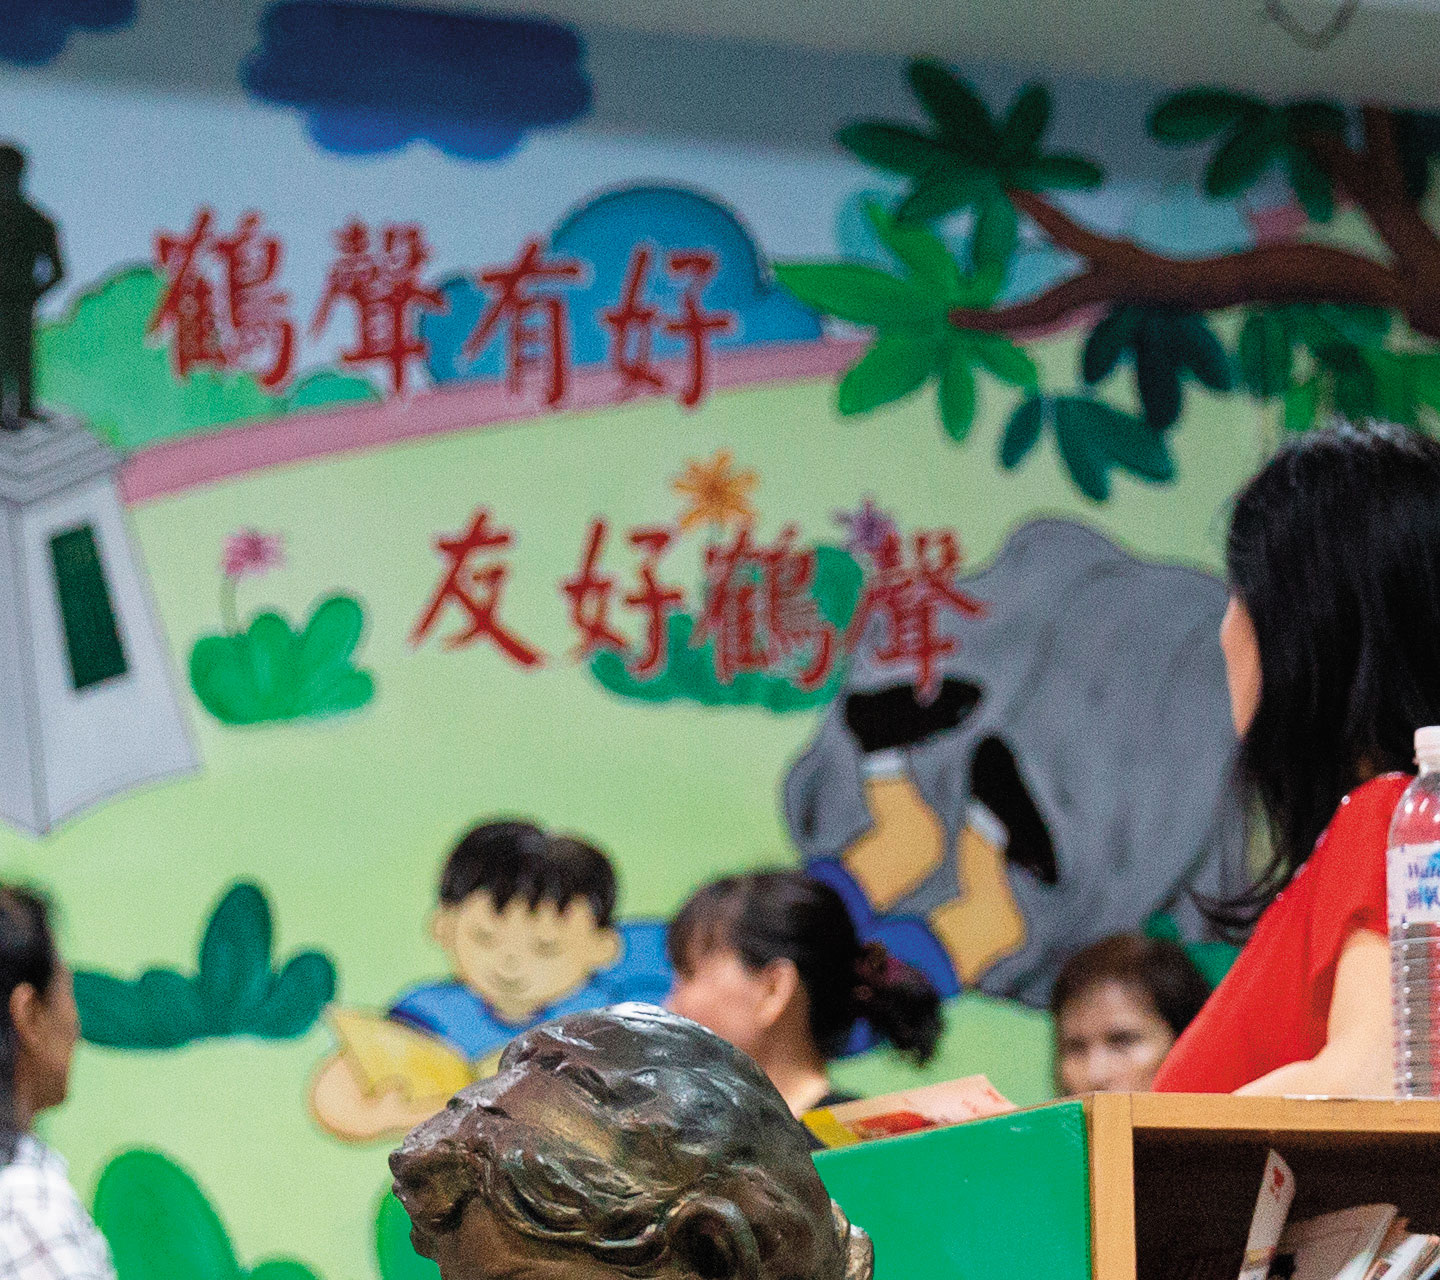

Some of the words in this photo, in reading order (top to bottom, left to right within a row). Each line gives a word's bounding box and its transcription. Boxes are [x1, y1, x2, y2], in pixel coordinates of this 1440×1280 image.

[146, 207, 738, 405] 鶴聲有好
[410, 508, 984, 703] 友好鶴聲
